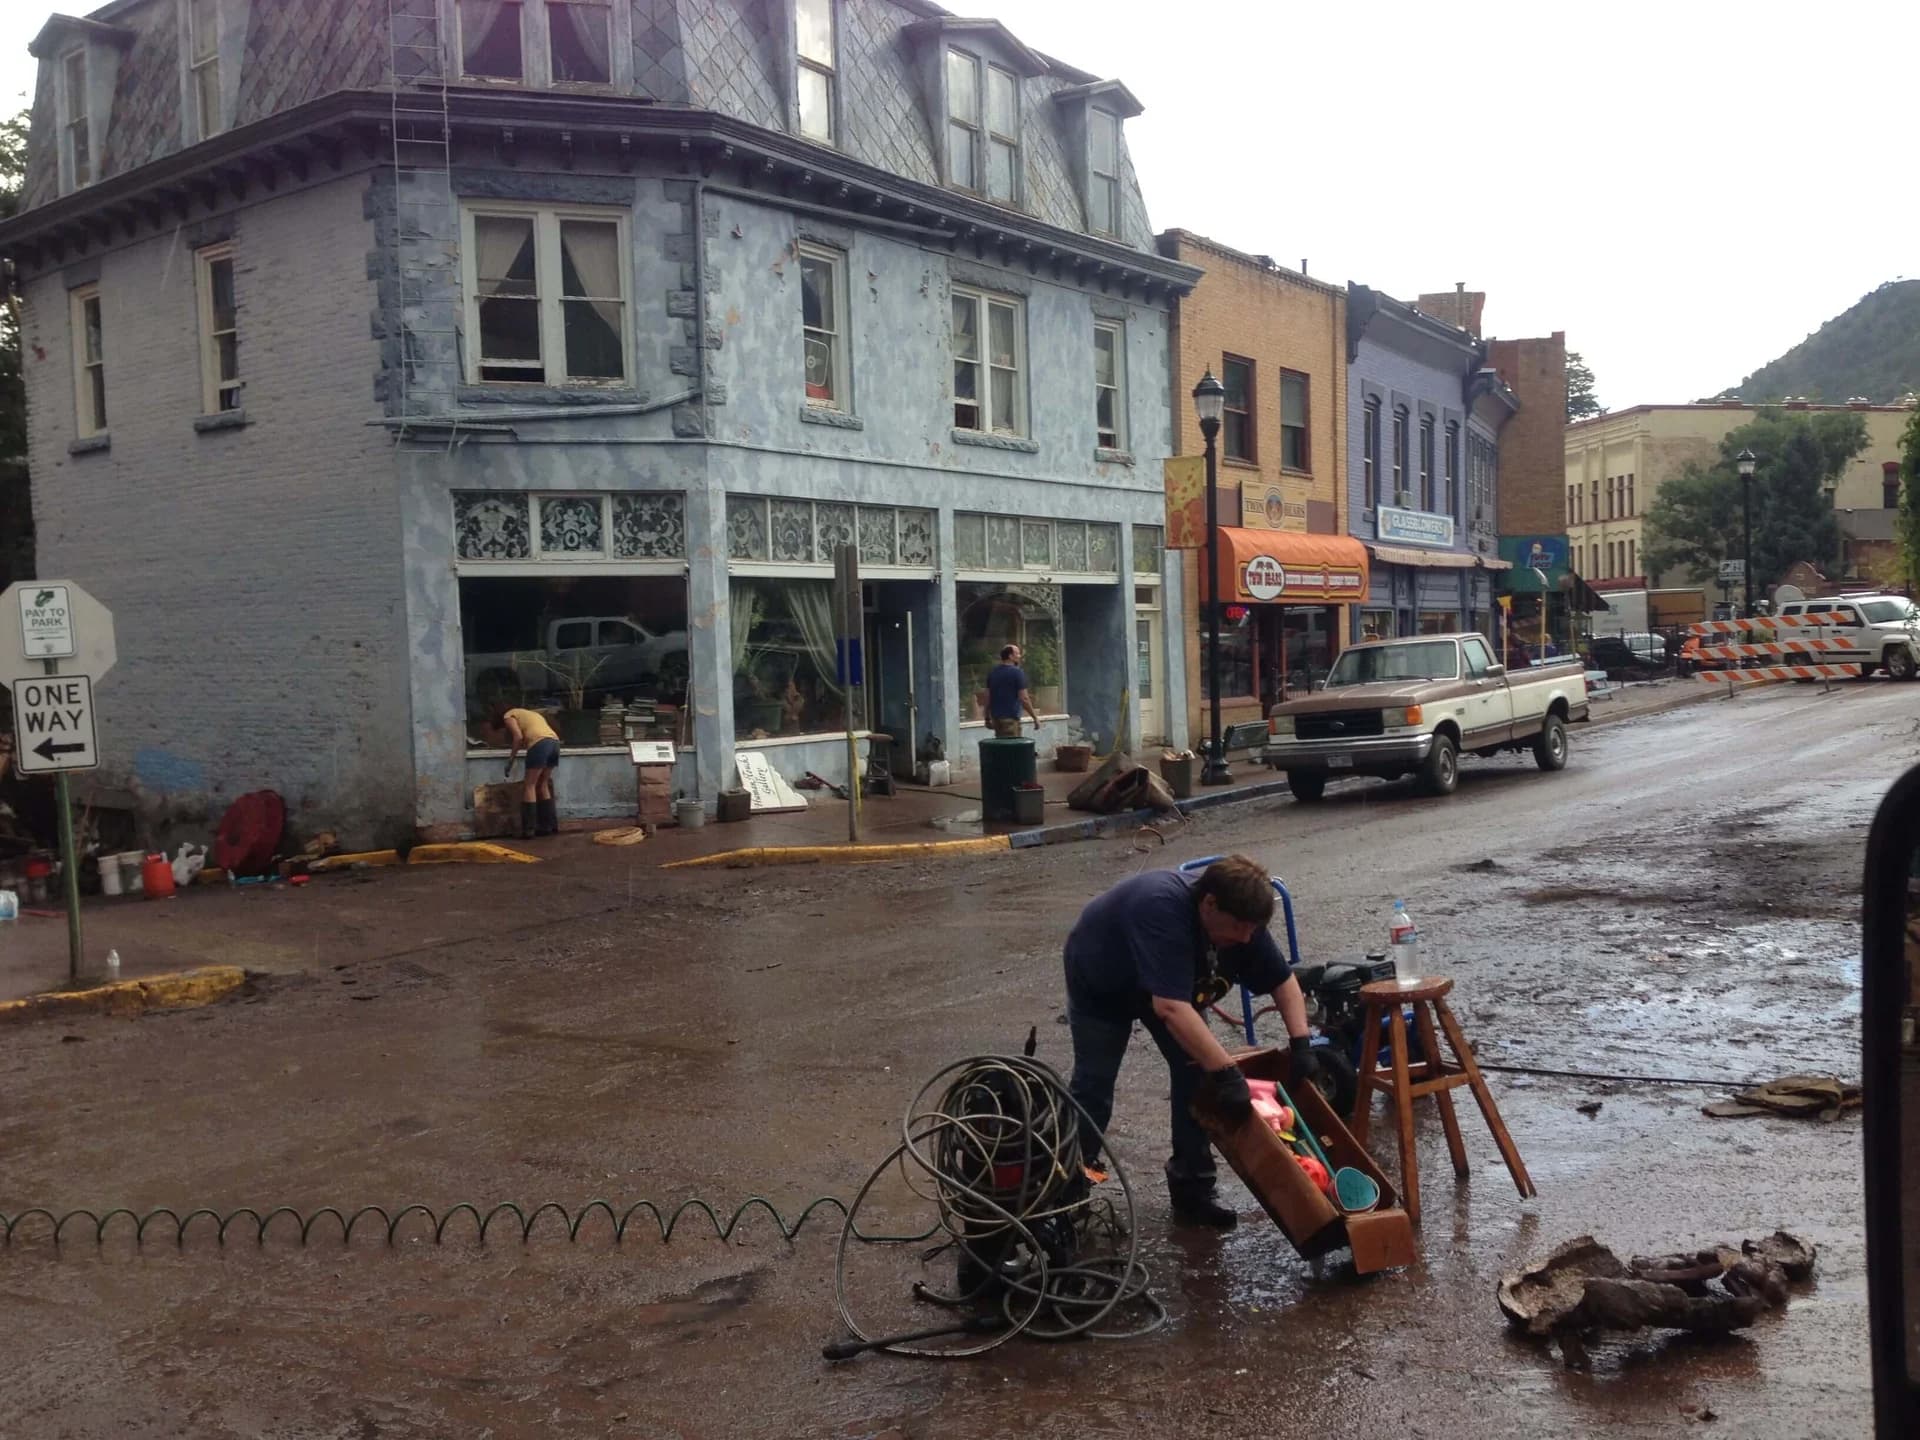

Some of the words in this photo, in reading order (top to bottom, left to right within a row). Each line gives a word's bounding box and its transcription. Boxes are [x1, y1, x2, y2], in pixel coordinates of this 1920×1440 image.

[1245, 501, 1264, 512] TWIN
[1248, 571, 1262, 585] TWIN
[25, 609, 46, 618] PAY
[49, 608, 65, 617] TO
[31, 618, 63, 627] PARK
[25, 684, 81, 707] ONE
[25, 709, 83, 733] WAY
